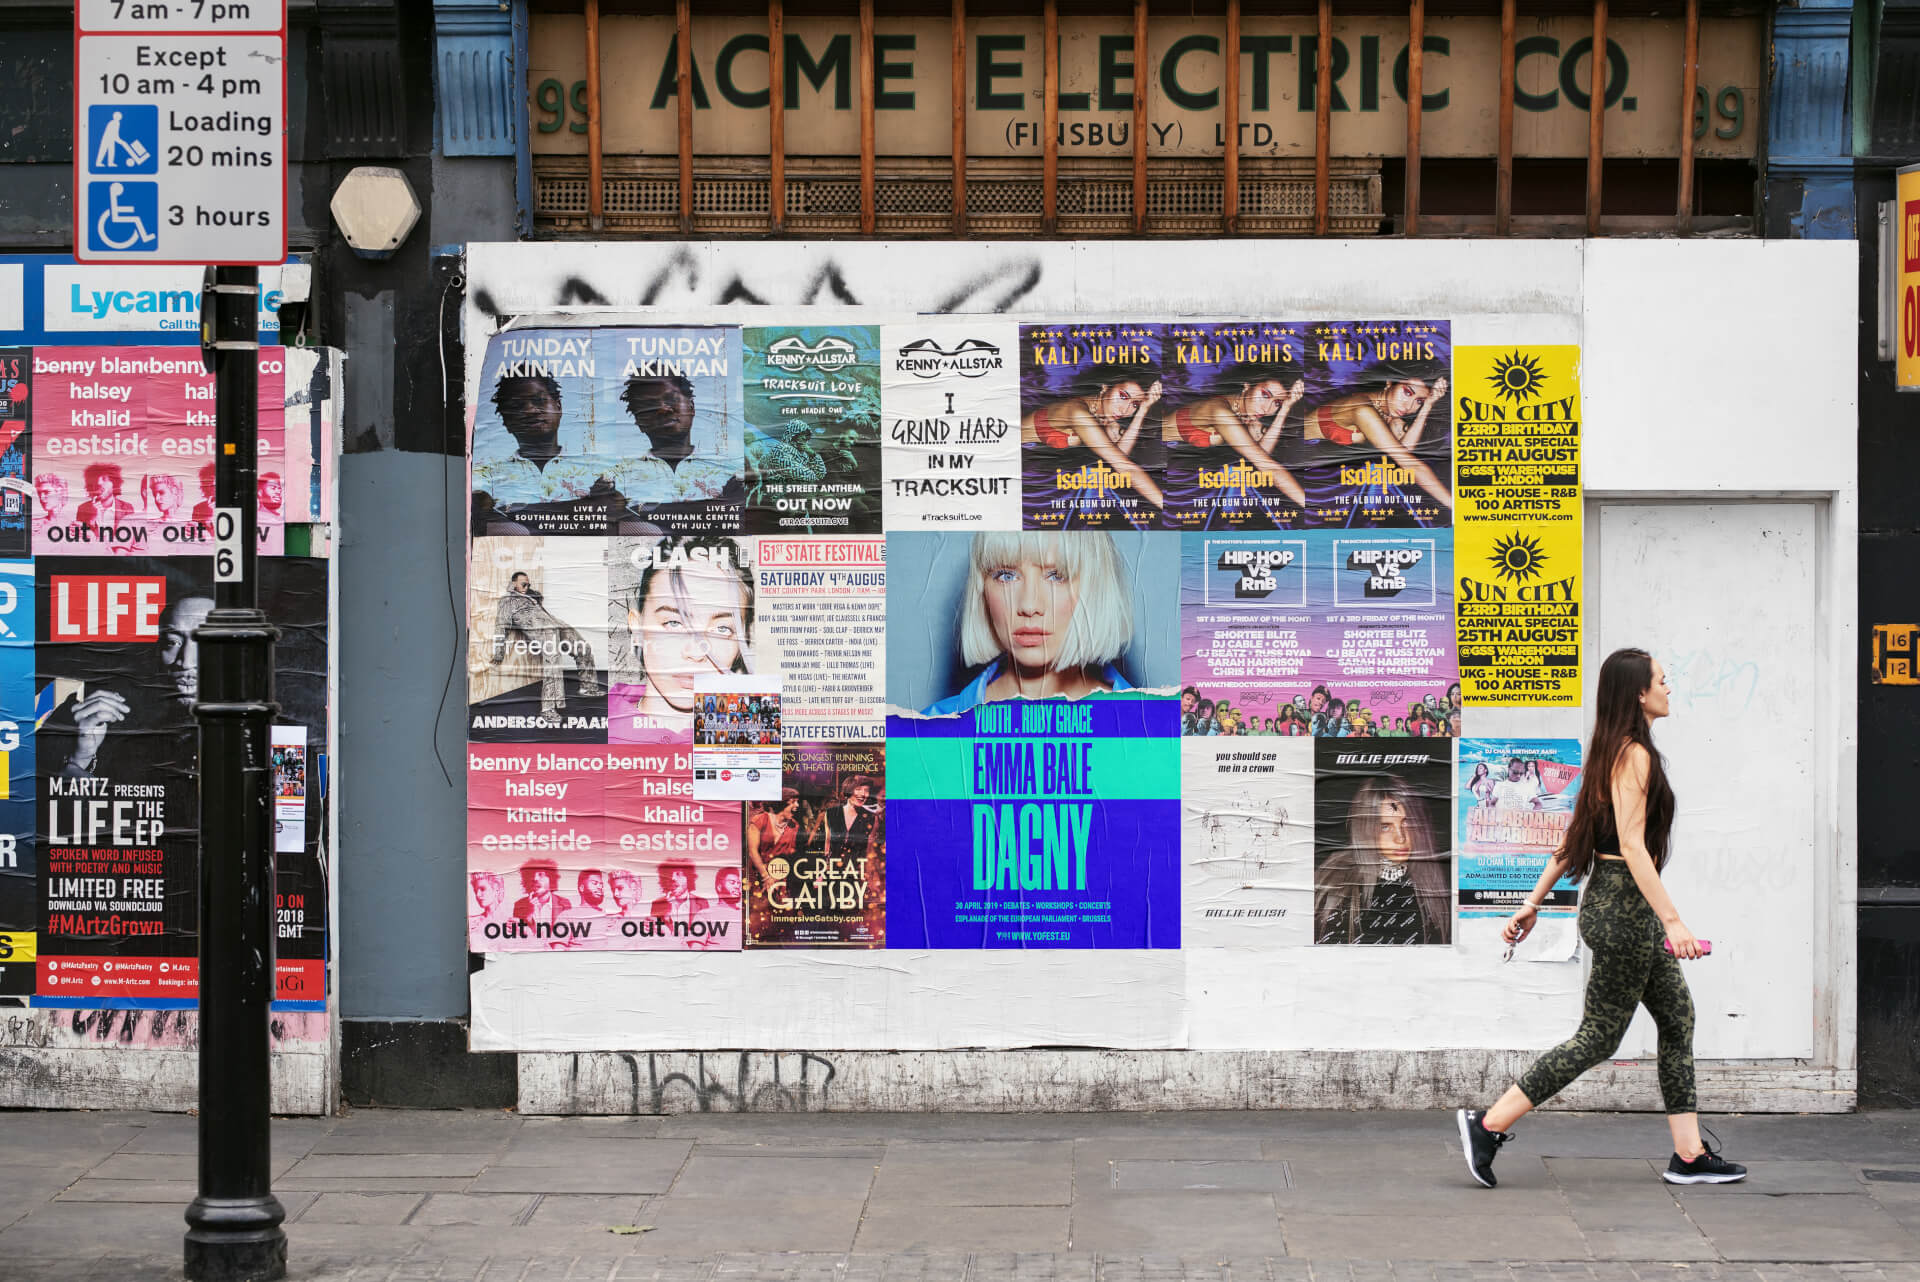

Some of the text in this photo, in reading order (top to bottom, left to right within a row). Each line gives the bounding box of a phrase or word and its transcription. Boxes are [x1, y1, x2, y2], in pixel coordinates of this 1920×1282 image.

[110, 0, 249, 22] 7 am 7 pm
[136, 47, 226, 68] Except
[650, 34, 1637, 112] ACME ELECTRIC CO.
[101, 75, 260, 97] 10 am 4 pm
[170, 111, 271, 135] Loading
[1006, 117, 1182, 150] (FISBUY)
[168, 147, 272, 167] 20 mins
[169, 206, 270, 226] 3 hours
[72, 284, 284, 319] Lycamle
[160, 320, 182, 329] Call
[502, 338, 592, 357] TUNDAY
[1035, 345, 1150, 364] KALI UCHIS
[1177, 344, 1292, 364] KALI UCHIS
[36, 357, 95, 376] benny
[495, 360, 595, 377] AKINTAN
[897, 359, 940, 371] KENNY
[70, 383, 132, 402] halsey
[831, 380, 861, 392] LOVE
[72, 411, 130, 426] khalid
[892, 418, 1007, 443] GRIND HARD
[1462, 424, 1573, 435] 23RD BIRTHDAY
[1458, 438, 1577, 447] CARNIVAL SPECIAL
[929, 455, 974, 468] IN MY
[1457, 449, 1578, 461] 25TH AUGUST
[1056, 460, 1131, 497] isolation
[1199, 458, 1273, 497] isolation
[1460, 466, 1576, 477] @GSS WAREHOUSE
[1492, 476, 1544, 484] LONDON
[788, 484, 817, 493] STREET
[820, 484, 861, 492] ANTHEM
[892, 478, 1009, 497] TRACKSUIT
[1459, 489, 1576, 498] UKG HOUSE R&B
[776, 499, 851, 510] OUT NOW
[1051, 500, 1065, 508] THE
[1070, 499, 1097, 508] ALBUM
[1101, 499, 1116, 507] OUT
[1475, 500, 1560, 509] 100 ARTISTS
[48, 525, 90, 542] out
[786, 545, 821, 561] STATE
[825, 545, 880, 561] FESTIVAL
[1248, 564, 1271, 577] VS
[761, 573, 824, 586] SATURDAY
[58, 583, 159, 635] LIFE
[493, 635, 592, 655] Freedom
[1891, 634, 1907, 646] 16
[1890, 663, 1906, 675] 12
[472, 716, 560, 729] ANDERSON
[1022, 705, 1093, 733] RUBY GRACE
[470, 753, 603, 774] benny blanco
[1216, 753, 1230, 761] you
[1232, 752, 1260, 761] should
[974, 743, 1093, 794] EMMA BALE
[1218, 765, 1230, 773] me
[1233, 764, 1240, 772] in
[1250, 764, 1274, 773] crown
[50, 777, 164, 797] M.ARTZ PRESENTS
[506, 779, 568, 799] halsey
[136, 802, 164, 817] THE
[507, 808, 567, 823] khalid
[49, 801, 133, 845] LIFE
[136, 821, 164, 845] EP
[482, 829, 591, 851] eastside
[50, 849, 163, 861] SPOKEN WORD INFUSED
[973, 804, 1092, 891] DAGNY
[50, 863, 163, 874] WITH POETRY AND MUSIC
[794, 858, 867, 880] GREAT
[49, 878, 164, 899] LIMITED FREE
[768, 882, 867, 909] GATSBY
[49, 901, 162, 911] DOWNLOAD VIA SOUNDCLOUD
[288, 895, 304, 908] ON
[278, 910, 304, 922] 2018
[49, 915, 163, 935] #MArtzGrown
[279, 925, 303, 938] GMT
[485, 922, 591, 939] out now
